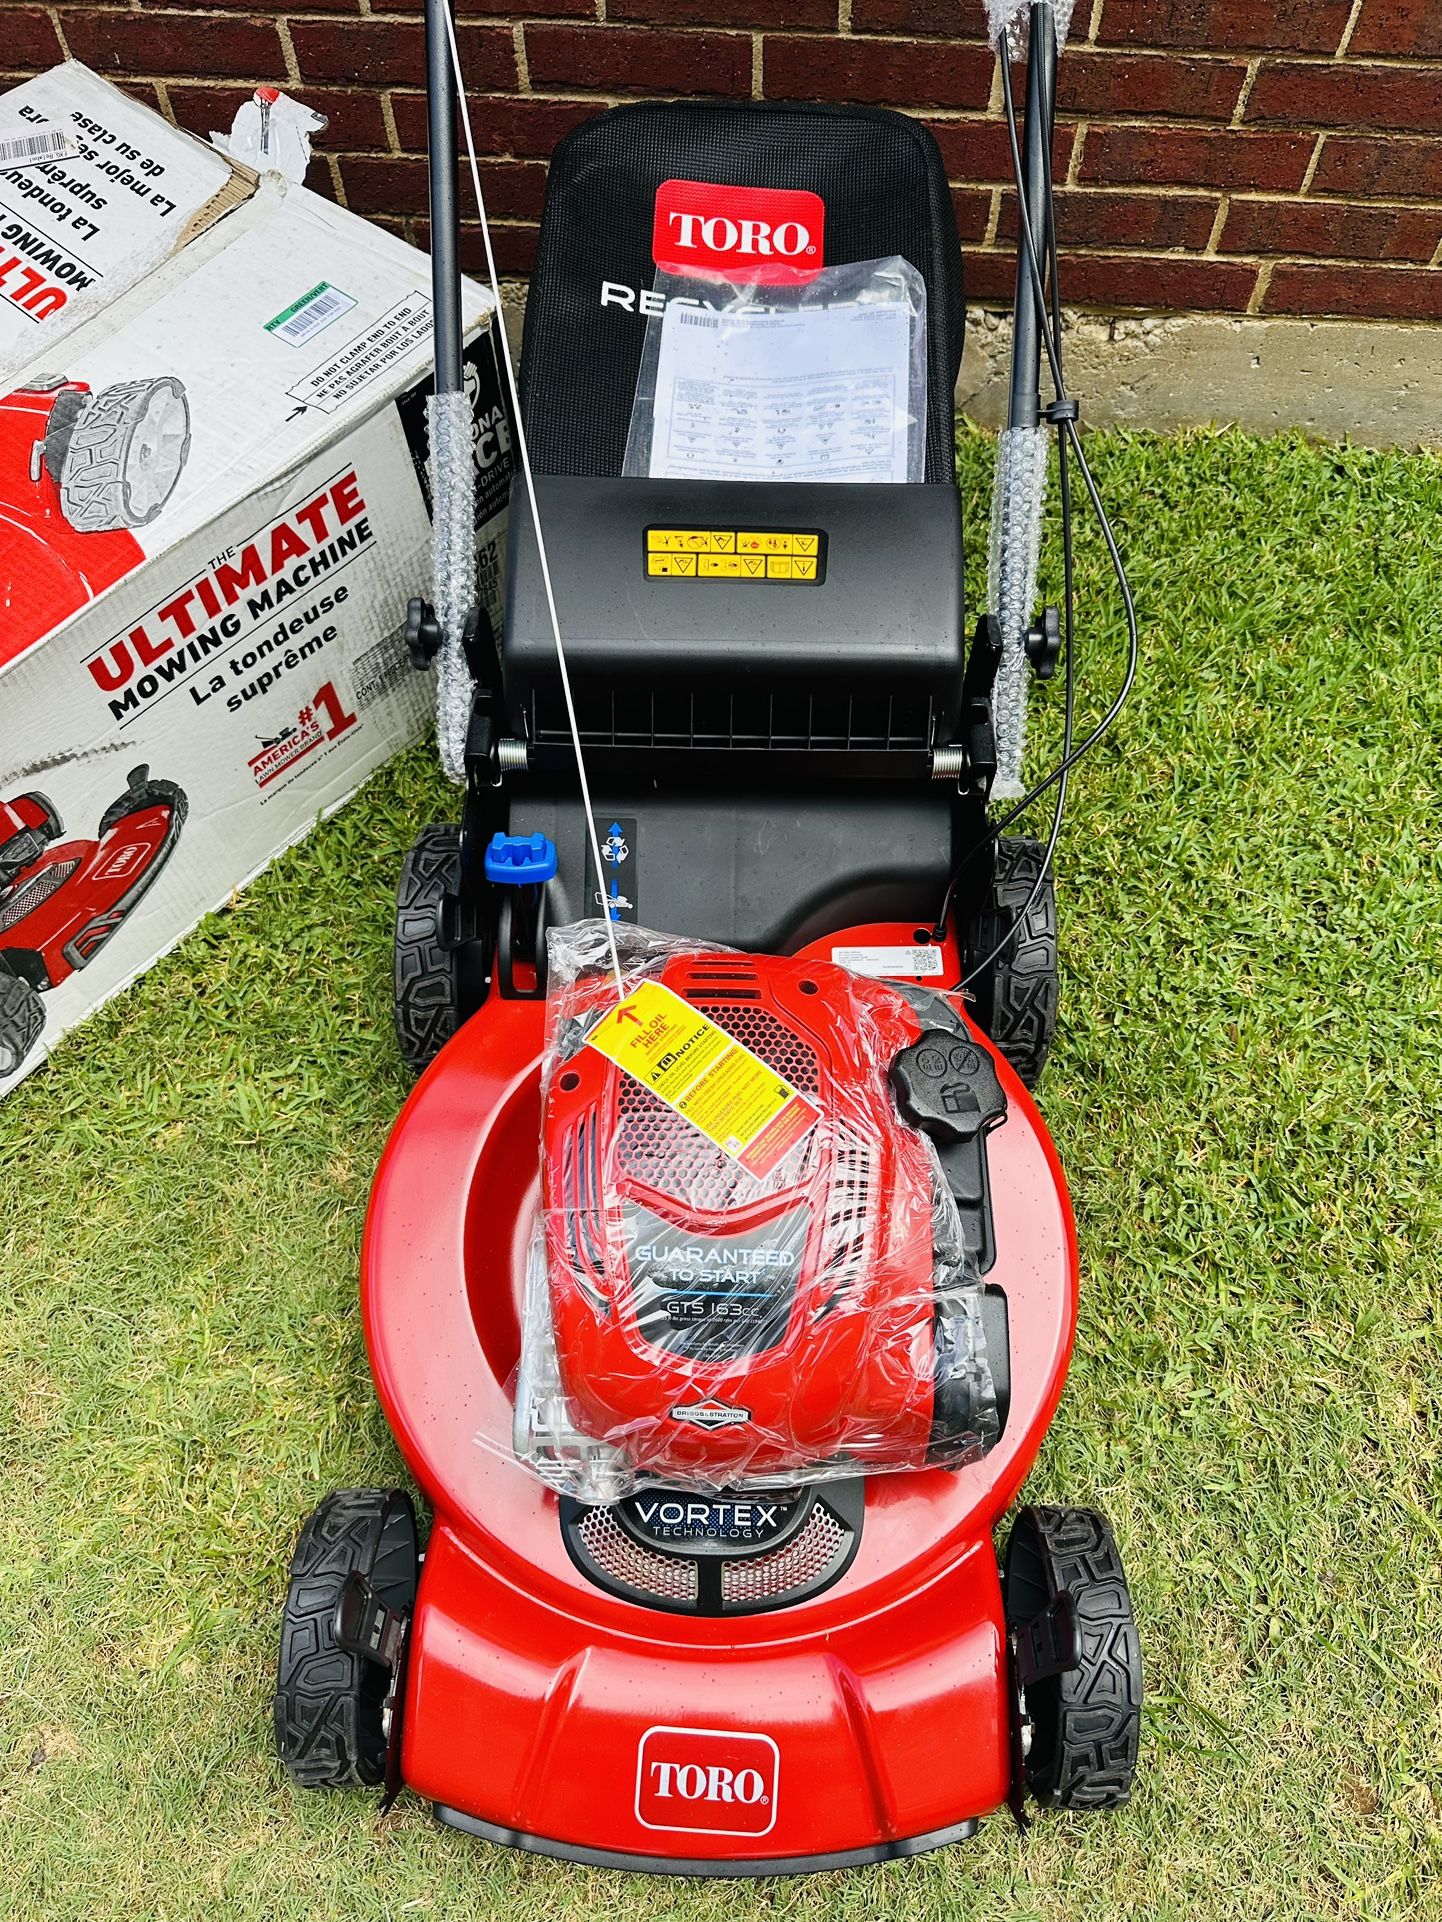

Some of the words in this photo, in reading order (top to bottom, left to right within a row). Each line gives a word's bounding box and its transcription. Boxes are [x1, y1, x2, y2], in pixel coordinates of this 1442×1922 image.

[70, 111, 117, 145] clase
[115, 142, 141, 161] su
[139, 158, 165, 177] de
[0, 170, 73, 222] tondeu
[35, 164, 108, 210] suprêm
[95, 160, 152, 197] mejor
[150, 194, 177, 217] La
[71, 216, 100, 241] La
[1, 224, 96, 291] MOWING
[0, 246, 67, 320] ULT
[266, 320, 280, 331] RTV
[311, 377, 325, 387] DO
[323, 363, 341, 378] NOT
[340, 342, 368, 365] CLAMP
[366, 328, 385, 343] END
[383, 320, 396, 331] TO
[394, 307, 412, 320] END
[316, 388, 330, 399] NE
[330, 375, 347, 389] PAS
[346, 348, 383, 377] AGRAFER
[380, 330, 403, 349] BOUT
[408, 310, 430, 326] BOUT
[333, 389, 347, 400] NO
[345, 362, 382, 390] SUJETAR
[381, 351, 400, 364] POR
[398, 338, 414, 352] LOS
[208, 546, 236, 570] THE
[87, 470, 367, 692] ULTIMATE
[107, 613, 242, 722] MOWING
[246, 516, 374, 621] MACHINE
[188, 672, 226, 706] La
[230, 583, 349, 677] tondeuse
[226, 624, 338, 713] suprême
[254, 721, 319, 776] AMERICA'S
[255, 767, 274, 784] LAWN
[275, 748, 299, 768] MOWER
[301, 731, 322, 750] BRAND
[105, 847, 137, 875] TORO
[630, 1030, 652, 1048] FILL
[649, 1014, 667, 1028] OIL
[642, 1023, 669, 1048] HERE
[675, 1024, 710, 1057] NOTICE
[685, 1078, 708, 1102] BEFORE
[708, 1047, 738, 1079] STARTING
[635, 1245, 795, 1267] GUARANTEED
[670, 1268, 694, 1281] TO
[699, 1269, 761, 1284] START
[666, 1301, 704, 1314] GTS
[653, 1526, 764, 1538] TECHNOLOGY
